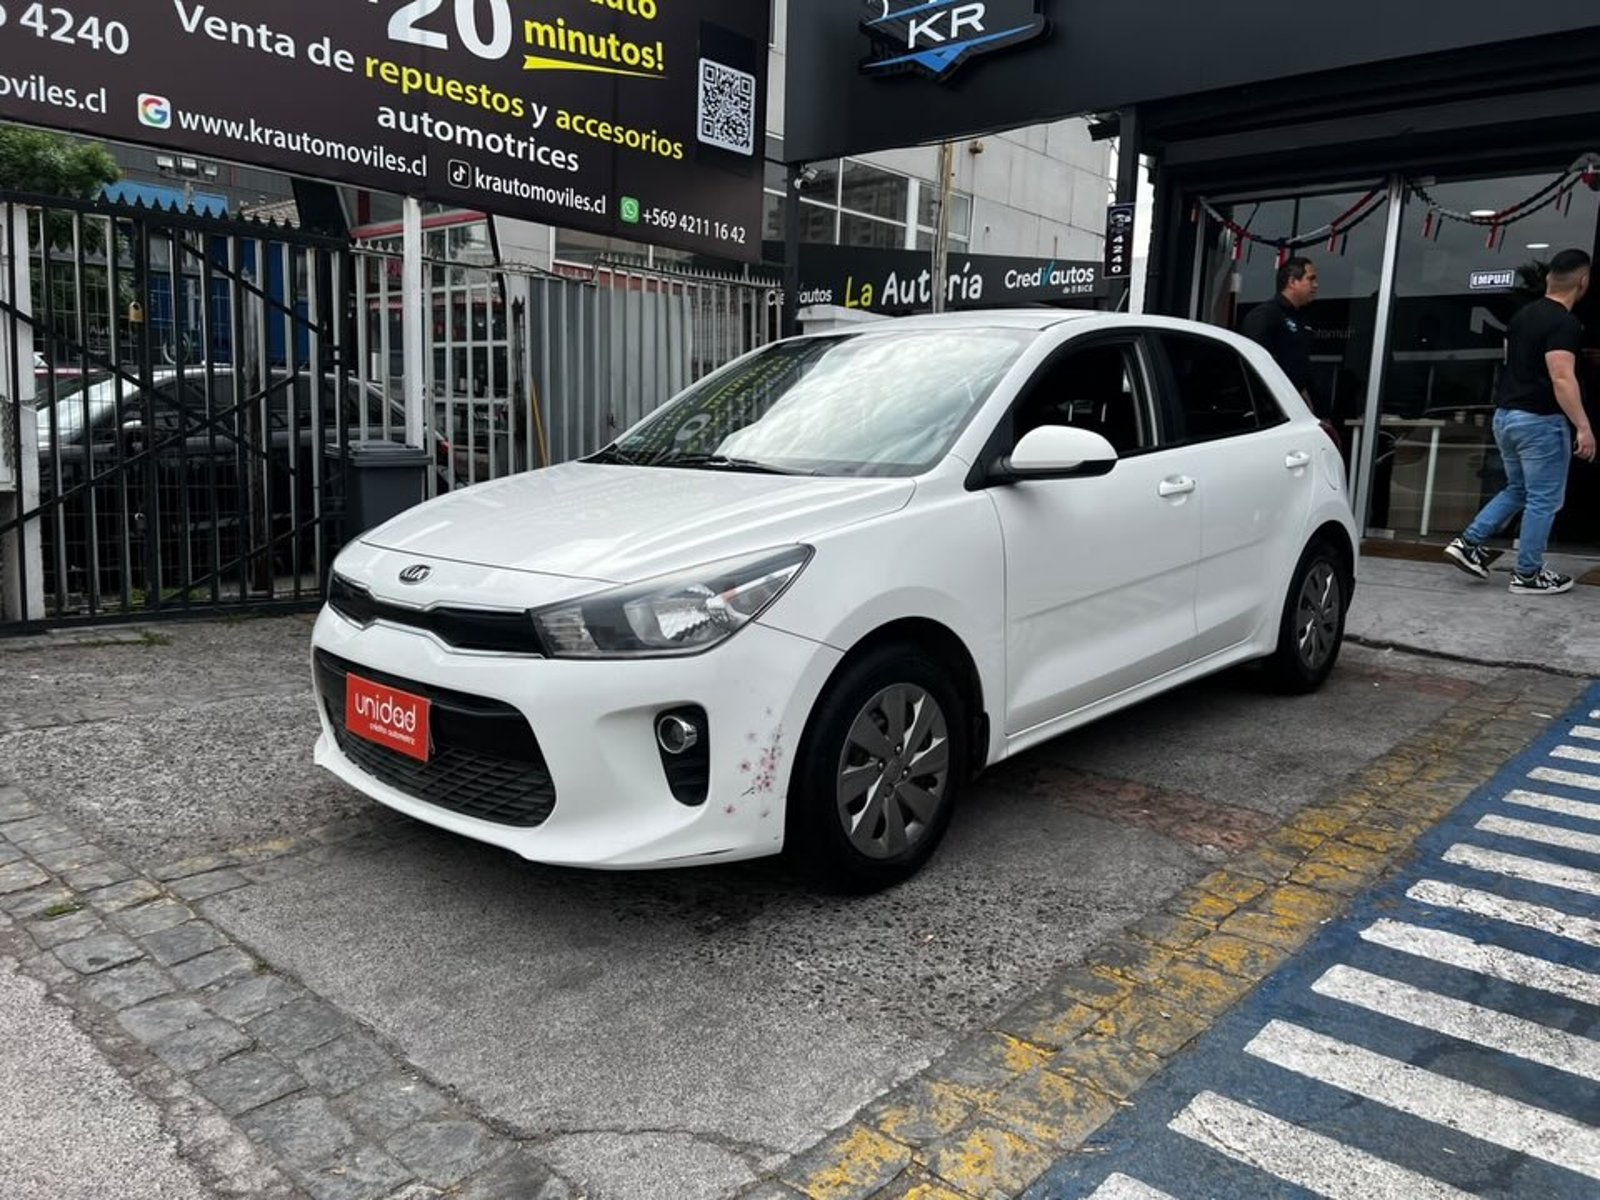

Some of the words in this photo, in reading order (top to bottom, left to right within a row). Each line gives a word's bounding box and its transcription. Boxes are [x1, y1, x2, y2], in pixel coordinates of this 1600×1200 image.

[20, 2, 130, 55] 4240
[523, 17, 664, 71] minutos!
[907, 2, 985, 49] KR
[172, 0, 296, 59] Venta
[308, 37, 355, 72] de
[365, 56, 525, 117] repuestos
[531, 102, 548, 128] y
[555, 109, 684, 175] accesorios
[177, 109, 428, 177] www.krautomoviles.cl
[377, 106, 579, 171] automotrices
[474, 166, 606, 214] krautomoviles.cl
[643, 207, 677, 229] +569
[844, 276, 873, 307] La
[881, 261, 982, 305] Autría
[354, 692, 416, 733] unidad
